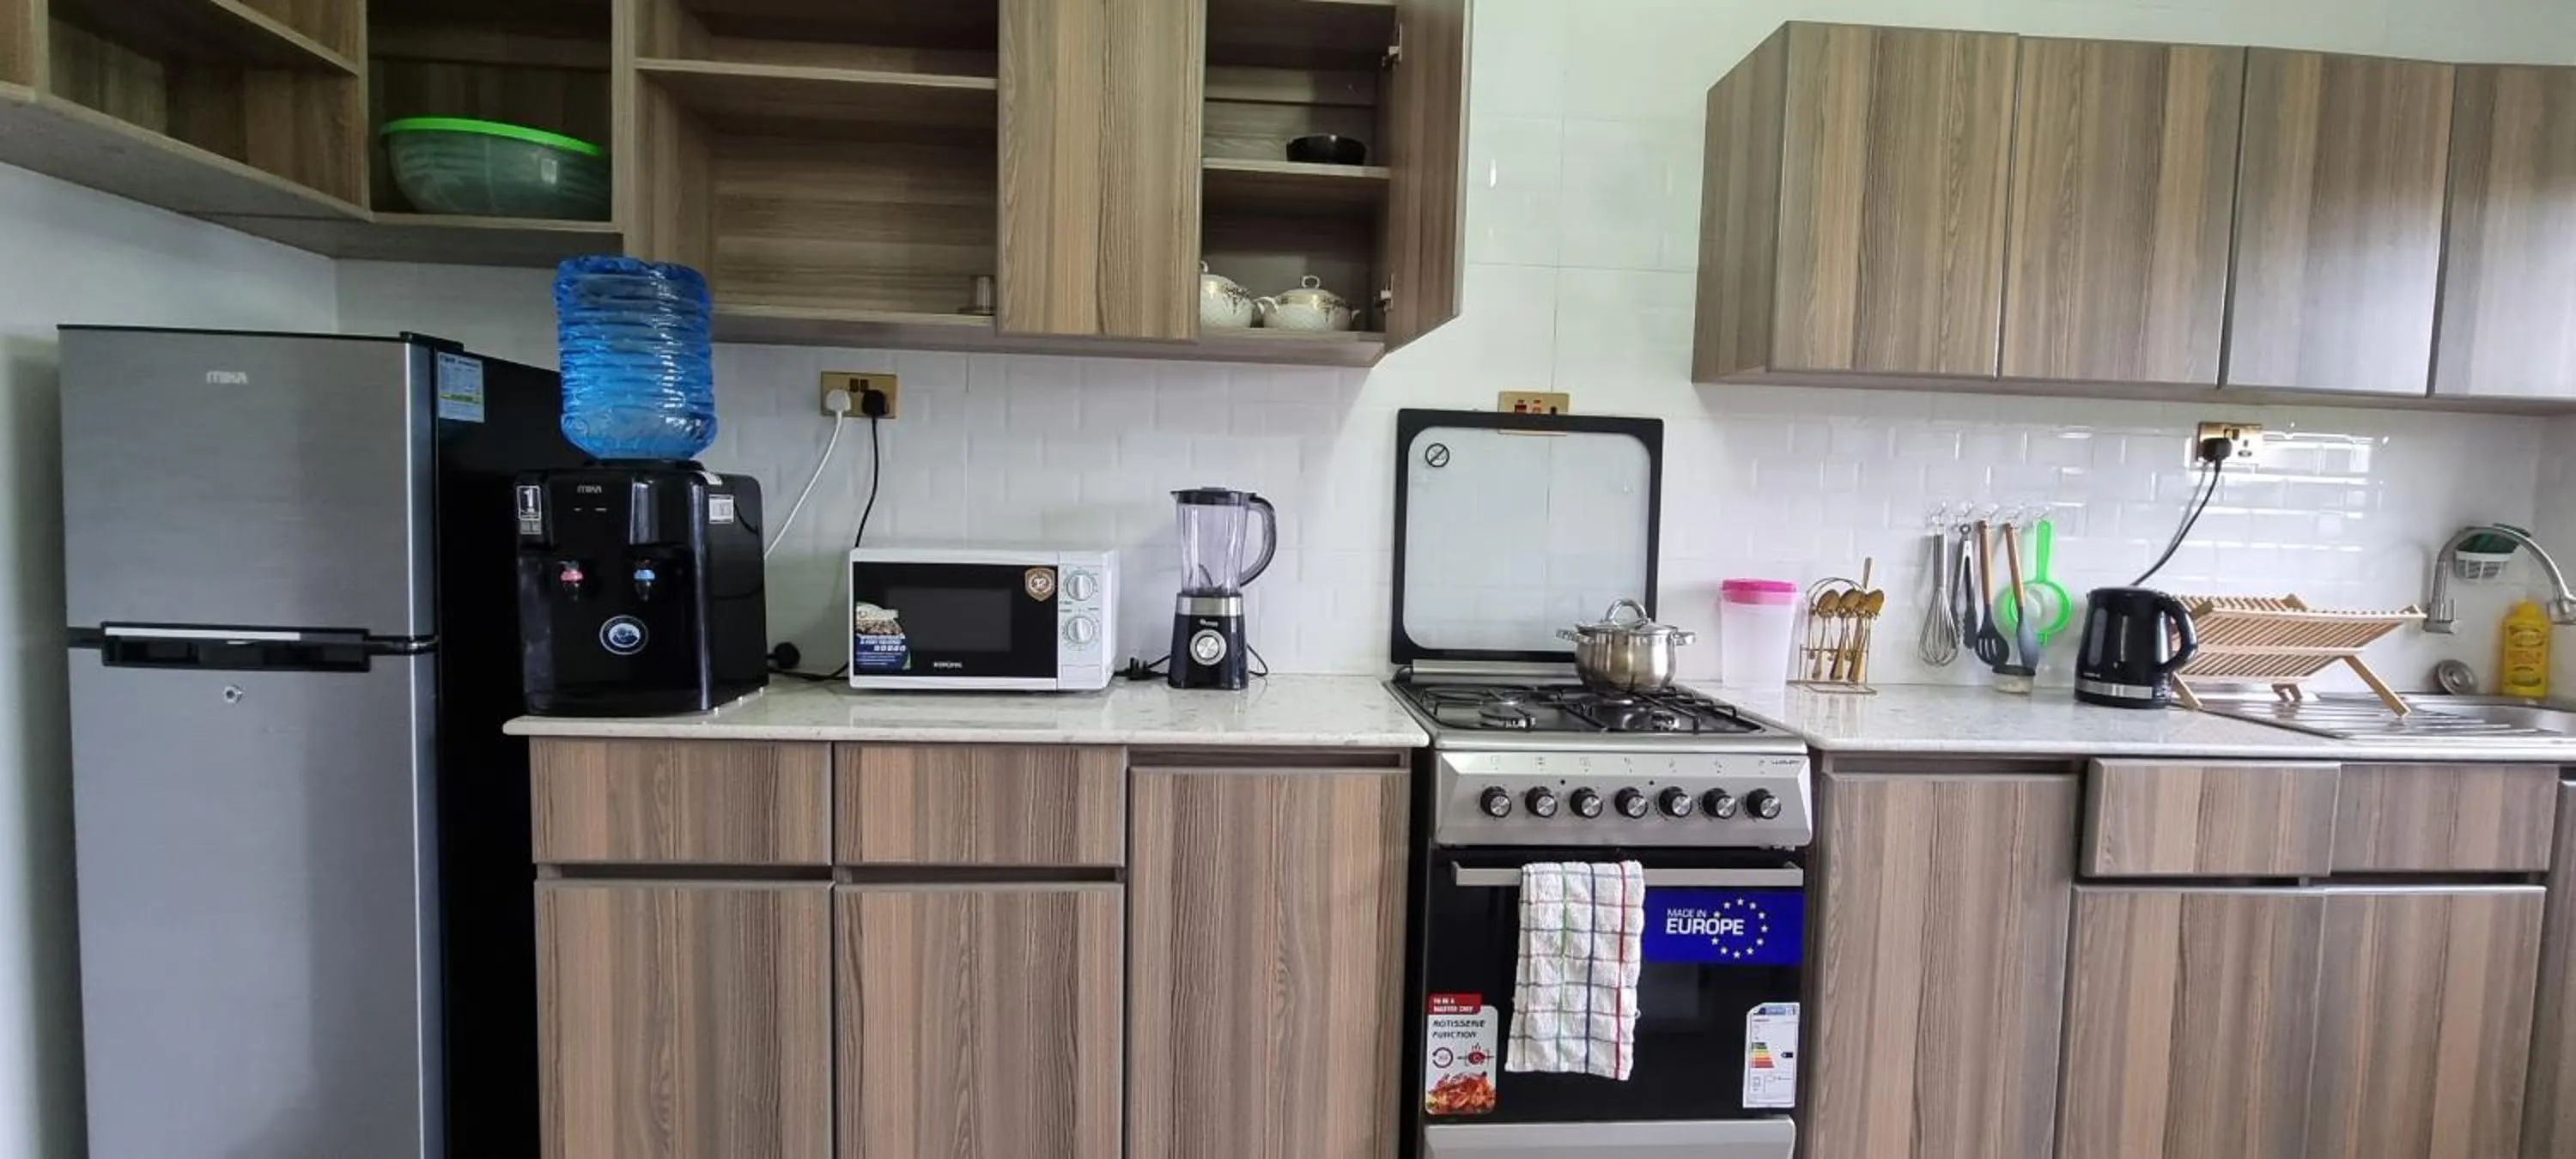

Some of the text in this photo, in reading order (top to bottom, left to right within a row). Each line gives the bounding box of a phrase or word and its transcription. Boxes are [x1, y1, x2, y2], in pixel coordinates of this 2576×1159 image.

[1667, 908, 1707, 918] MADE IN
[1666, 918, 1745, 936] EUROPE
